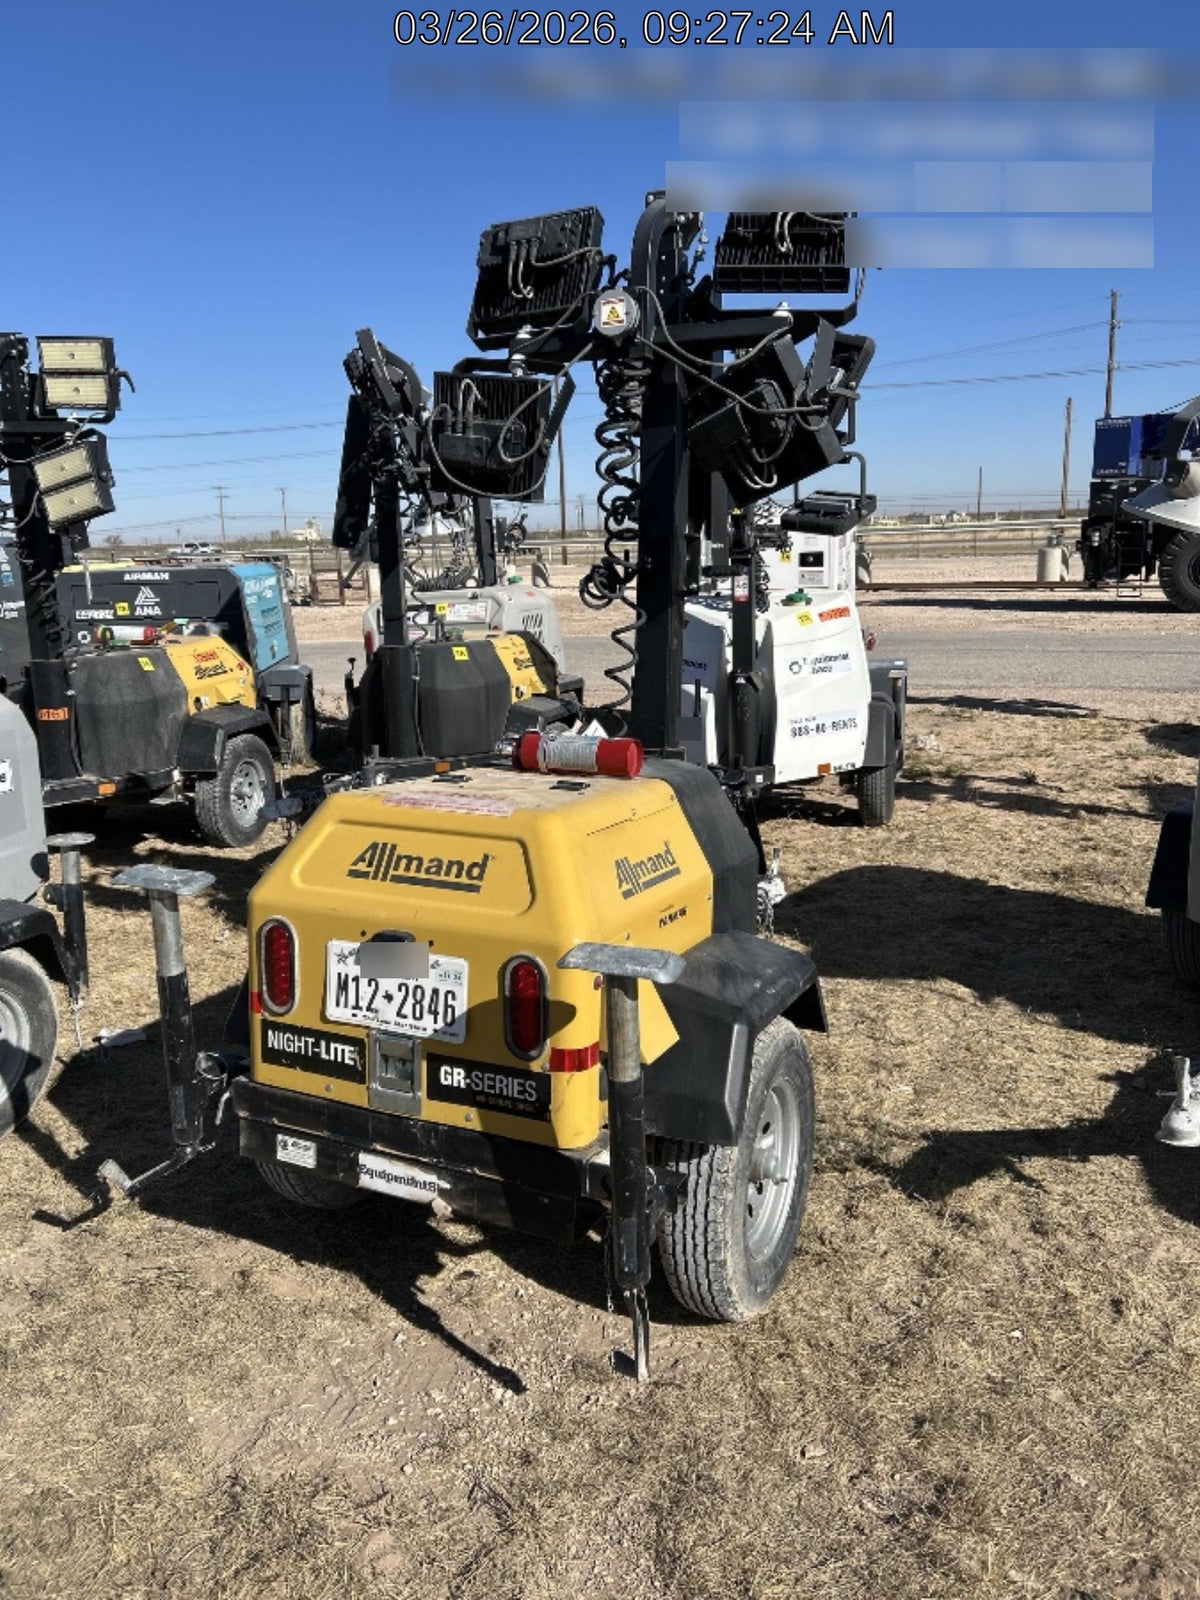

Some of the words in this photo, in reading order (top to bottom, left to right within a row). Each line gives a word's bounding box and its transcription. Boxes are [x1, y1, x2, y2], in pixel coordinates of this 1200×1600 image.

[348, 841, 490, 887] Allmand
[615, 840, 677, 896] Allmand
[395, 983, 457, 1028] 2846
[267, 1029, 357, 1066] NIGHT-LITE
[439, 1065, 537, 1102] GR-SERIES
